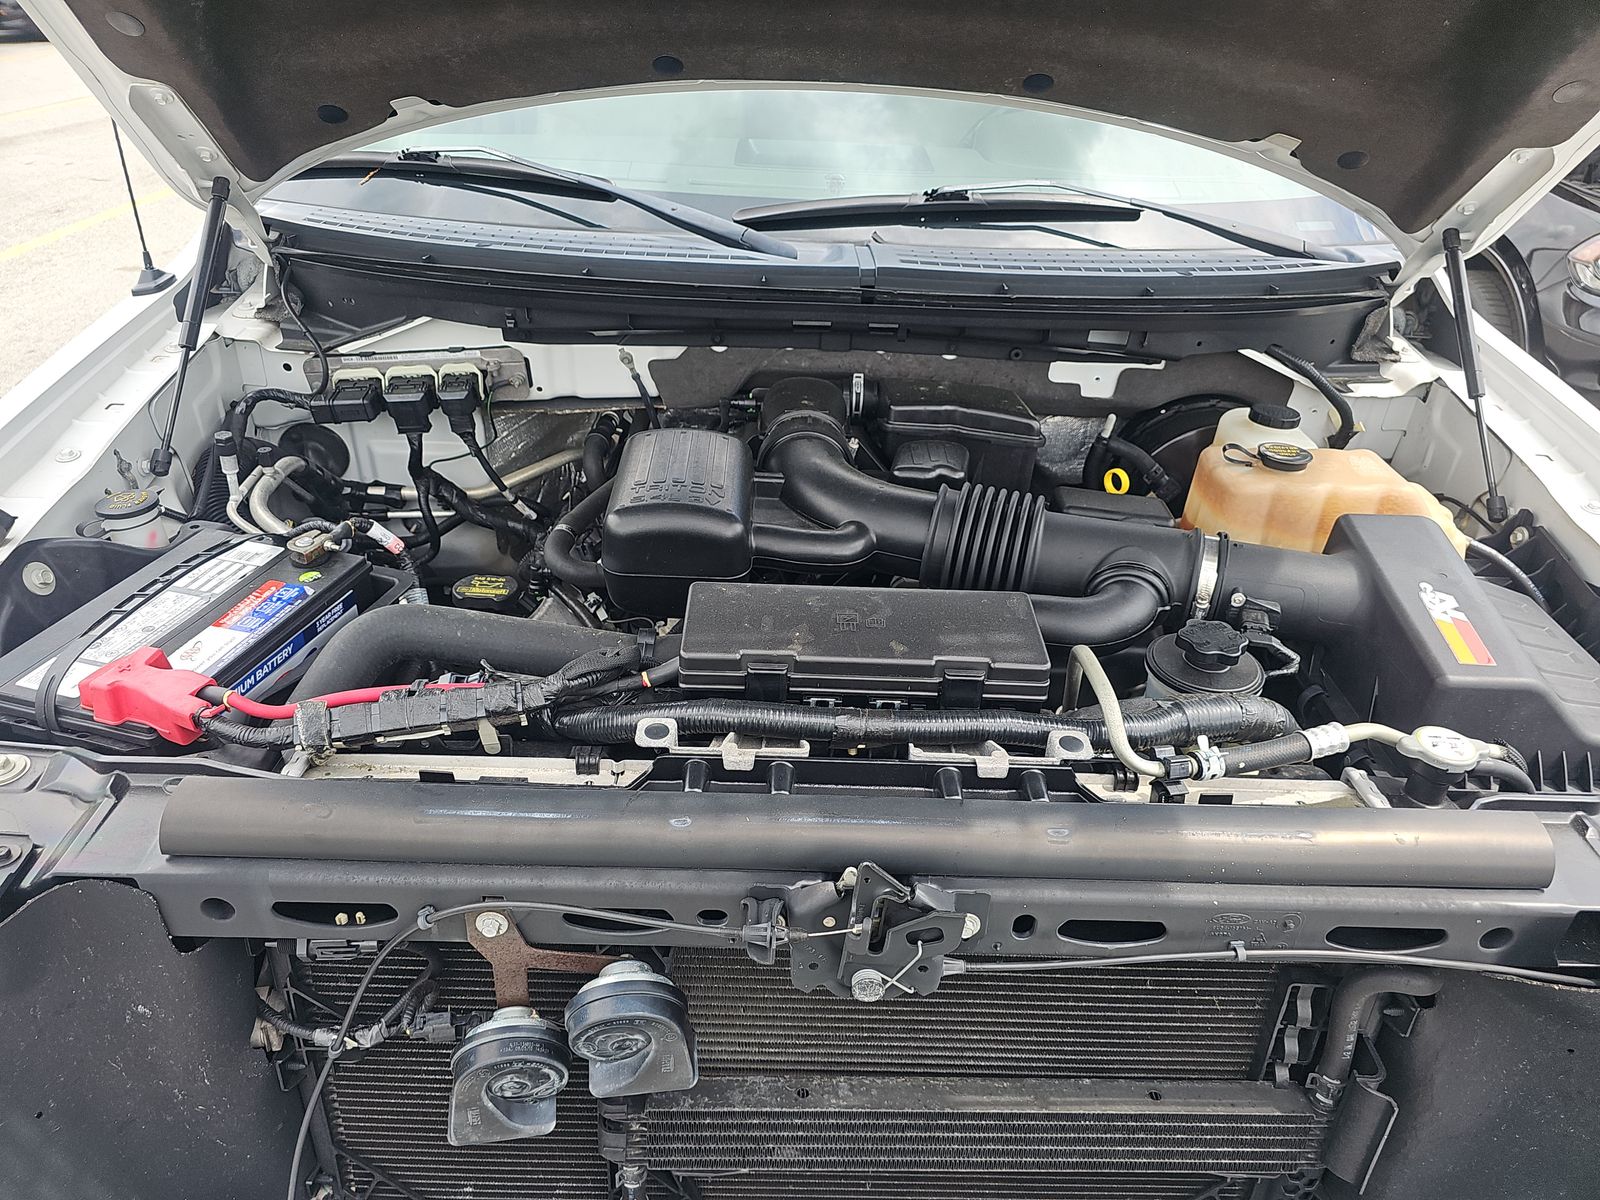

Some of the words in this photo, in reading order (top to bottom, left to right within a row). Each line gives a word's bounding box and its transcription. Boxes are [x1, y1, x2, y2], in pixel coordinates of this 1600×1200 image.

[630, 494, 681, 504] 5.4L
[688, 495, 721, 506] 3V
[631, 484, 726, 499] TRITON
[471, 587, 503, 595] Motorcraft
[317, 609, 344, 632] REPLACEMENT
[320, 612, 332, 624] YEAR
[331, 602, 344, 616] FREE
[256, 643, 294, 681] BATTERY
